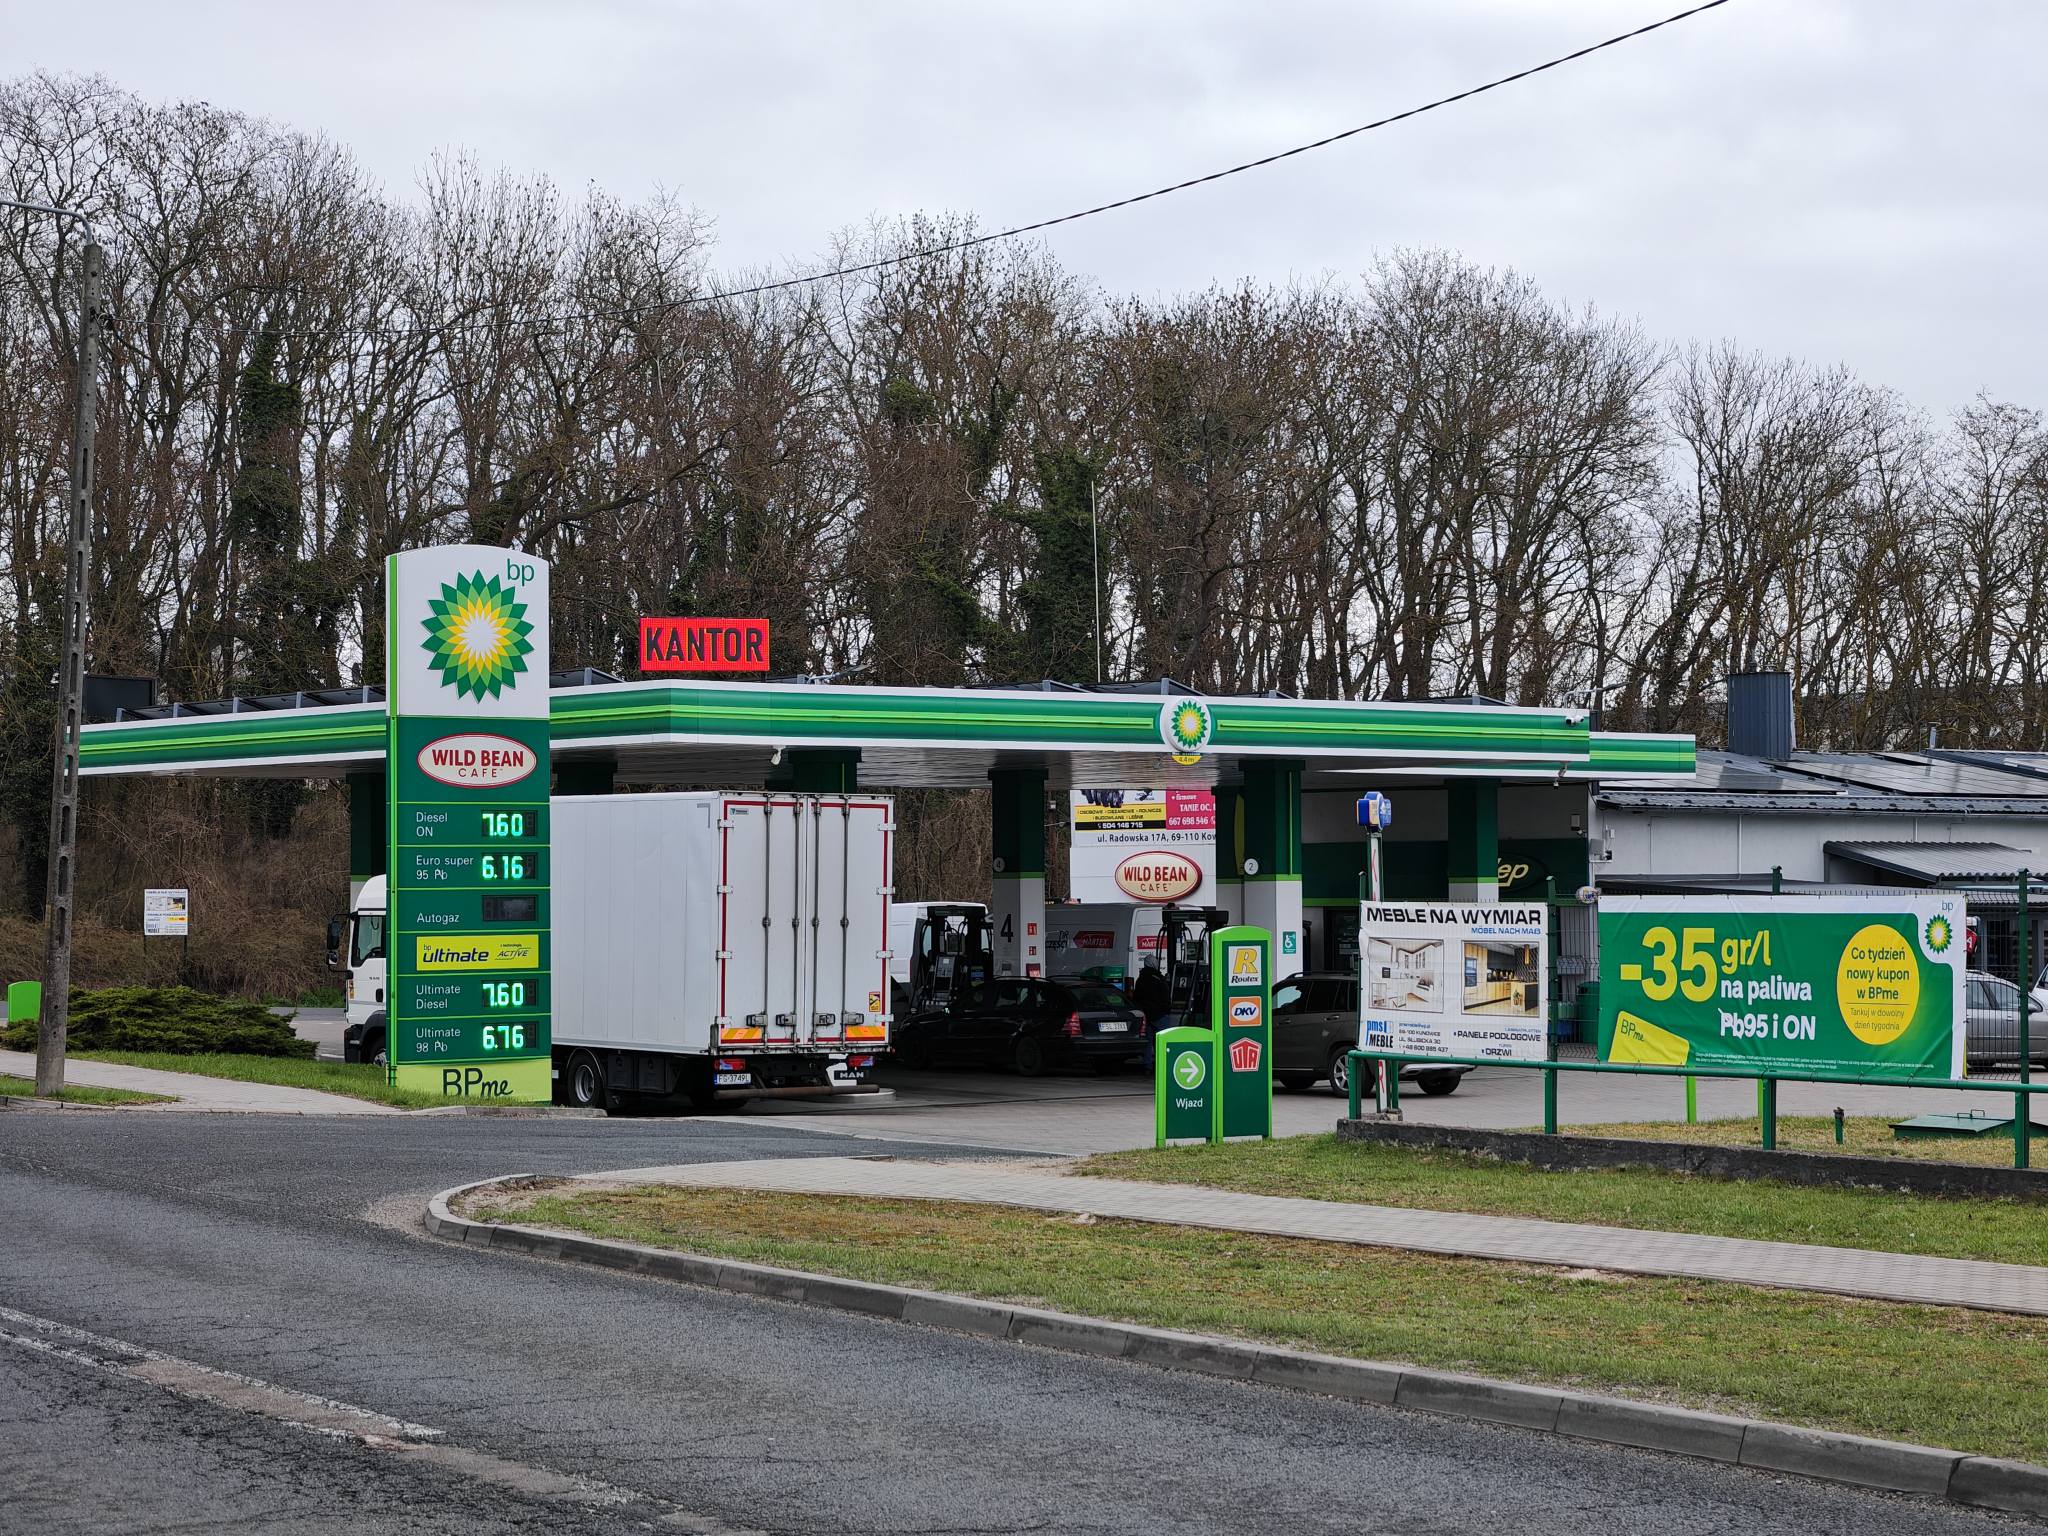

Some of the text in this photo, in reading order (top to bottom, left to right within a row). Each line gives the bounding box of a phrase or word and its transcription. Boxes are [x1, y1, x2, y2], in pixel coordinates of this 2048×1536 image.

[507, 558, 534, 586] bp
[646, 627, 764, 662] KANTOR
[432, 749, 524, 767] WILD BEAN
[458, 768, 498, 778] CAFE
[416, 812, 523, 836] Diesel 7.60
[1168, 816, 1180, 826] 667
[416, 826, 433, 837] ON
[1097, 834, 1108, 842] ul.
[1110, 834, 1148, 842] Radowska
[1152, 833, 1169, 842] 17A,
[1172, 832, 1199, 841] 69-110
[416, 855, 524, 879] Euro super 6.16
[1124, 866, 1188, 882] WILD BEAN
[1248, 862, 1254, 872] 2
[416, 870, 428, 880] 95
[1140, 883, 1168, 892] CAFE
[1942, 901, 1954, 912] bp
[416, 913, 460, 925] Autogaz
[1367, 908, 1541, 925] MEBLE NA WYMIAR
[1000, 914, 1014, 942] 4
[1472, 926, 1497, 934] MÖBEL
[422, 948, 529, 962] ultimate ACTIVE
[1852, 947, 1906, 963] Co tydzień
[1620, 926, 1772, 1002] -35 gr/l
[1231, 975, 1258, 984] Routex
[1846, 967, 1910, 982] nowy kupon
[416, 983, 524, 1006] Ultimate 7.60
[1720, 974, 1812, 1006] na paliwa
[1856, 986, 1898, 1000] w BPme
[416, 998, 448, 1009] Diesel
[1234, 1006, 1257, 1016] DKV
[1850, 1008, 1870, 1017] Tankuj
[1877, 1008, 1904, 1018] dowolny
[1620, 1019, 1644, 1042] BPme
[1719, 1010, 1816, 1040] Pb95 i ON
[1854, 1021, 1900, 1031] dzień tygodnia
[416, 1026, 524, 1049] Ultimate 6.76
[1369, 1034, 1394, 1048] MEBLE
[1458, 1030, 1541, 1042] PANELE PODŁOGOWE
[416, 1042, 428, 1052] 98
[1485, 1048, 1512, 1056] DRZWI
[1232, 1045, 1258, 1069] UTA
[442, 1067, 514, 1098] BPme
[1176, 1098, 1203, 1110] Wjazd
